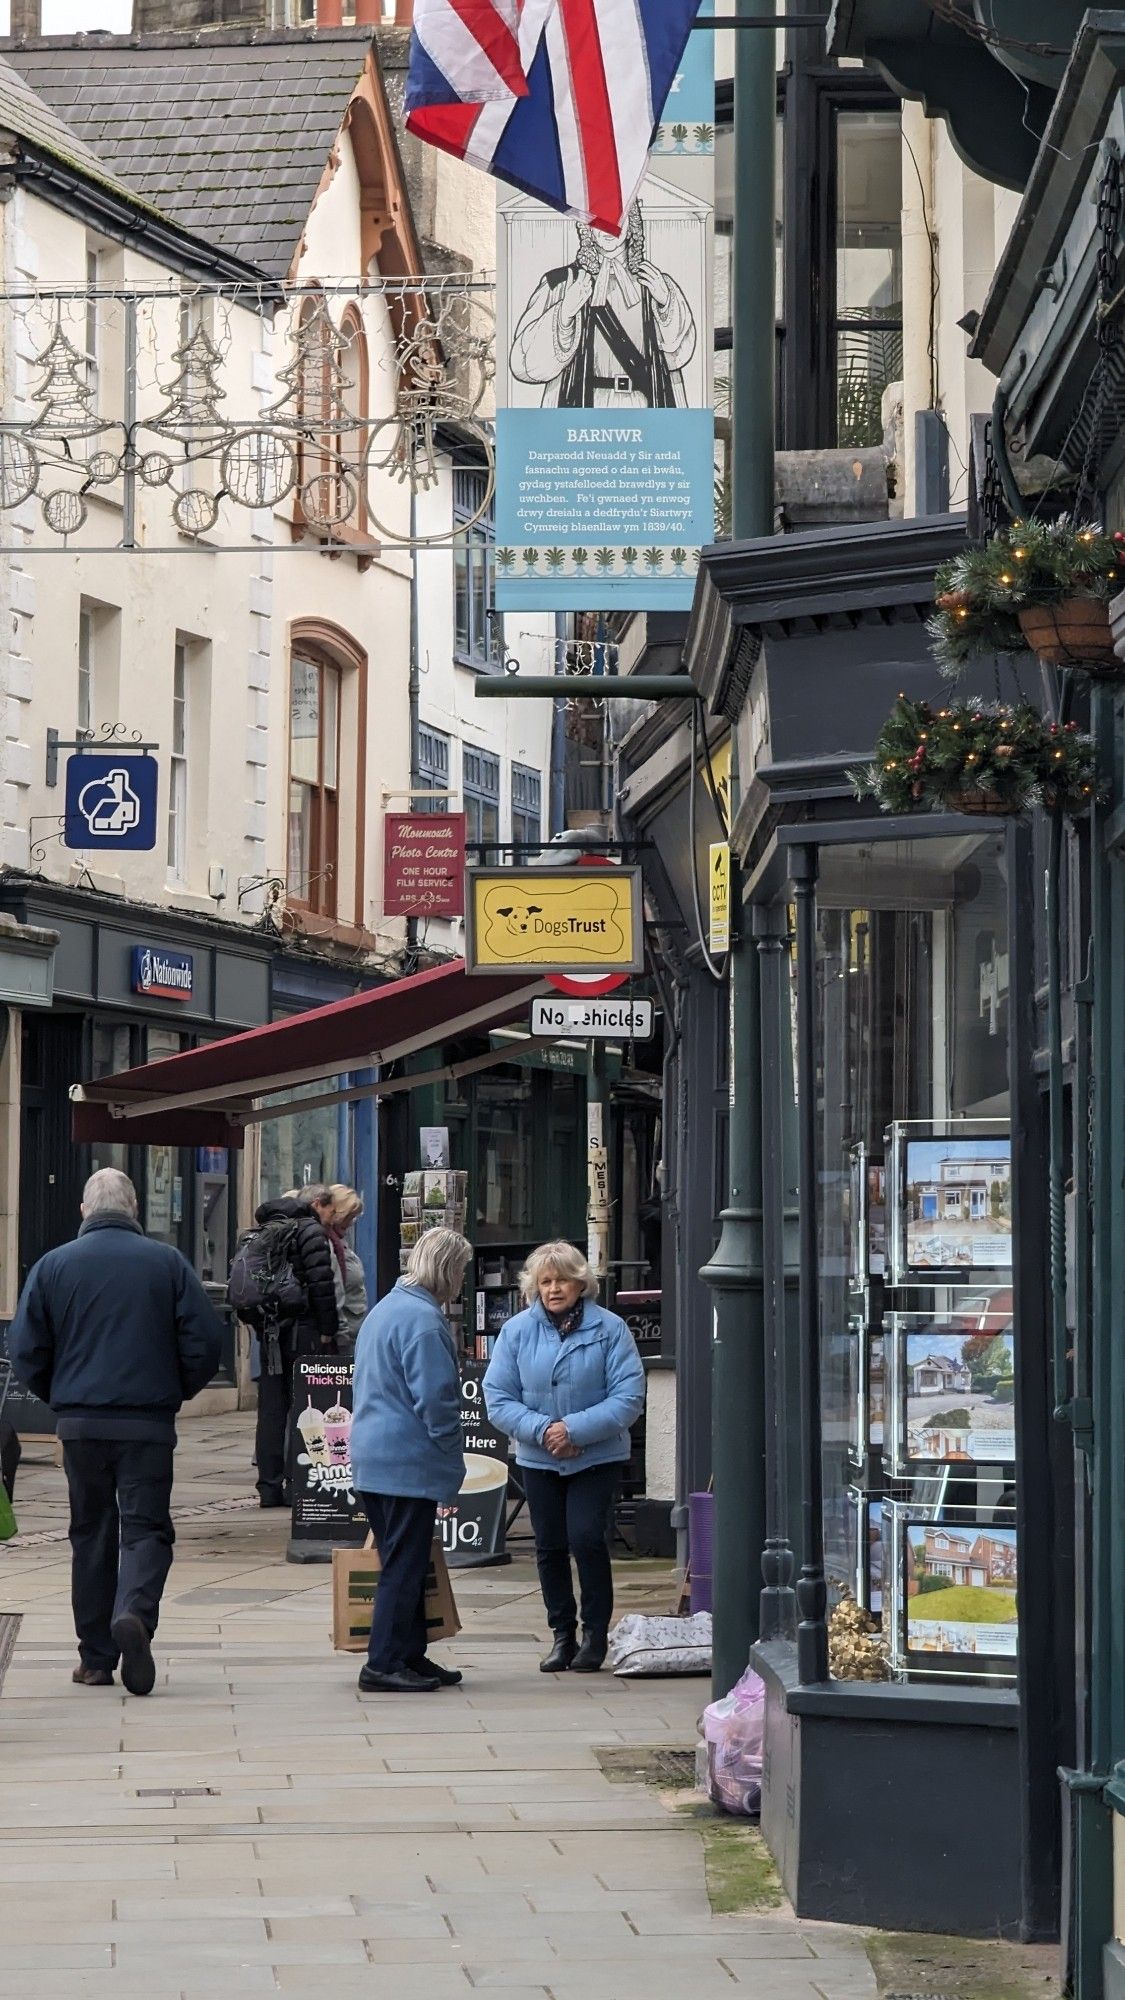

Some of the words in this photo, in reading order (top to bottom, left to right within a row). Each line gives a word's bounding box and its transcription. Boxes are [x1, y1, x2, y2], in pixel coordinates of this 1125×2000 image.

[567, 429, 642, 442] BARNWR
[528, 451, 584, 461] Darparodd
[587, 451, 626, 460] Neuadd
[638, 451, 652, 460] Sir
[654, 451, 681, 460] ardal
[525, 466, 569, 474] fasnachu
[572, 466, 608, 476] agored
[620, 466, 638, 474] dan
[642, 466, 651, 474] ei
[519, 480, 551, 490] gydag
[555, 480, 616, 490] ystafelloedd
[619, 480, 666, 490] brawdlys
[678, 481, 690, 489] sir
[520, 494, 568, 503] uwchben.
[597, 494, 637, 504] gwnaed
[517, 509, 543, 518] drwy
[546, 509, 582, 517] dreialu
[650, 509, 692, 519] Siartwyr
[524, 523, 568, 533] Cymreig
[571, 523, 620, 531] blaenllaw
[643, 522, 685, 532] 1839/40.
[398, 825, 453, 838] Monmouth
[392, 845, 422, 858] Photo
[426, 846, 458, 858] Centre
[397, 879, 415, 887] FILM
[712, 884, 727, 901] CCTV
[534, 918, 606, 936] DogsTrust
[153, 957, 192, 988] Nationwide
[540, 1008, 564, 1025] No
[569, 1008, 644, 1026] ehicles
[301, 1364, 347, 1373] Delicious
[305, 1375, 333, 1385] Thick
[466, 1436, 496, 1448] Here
